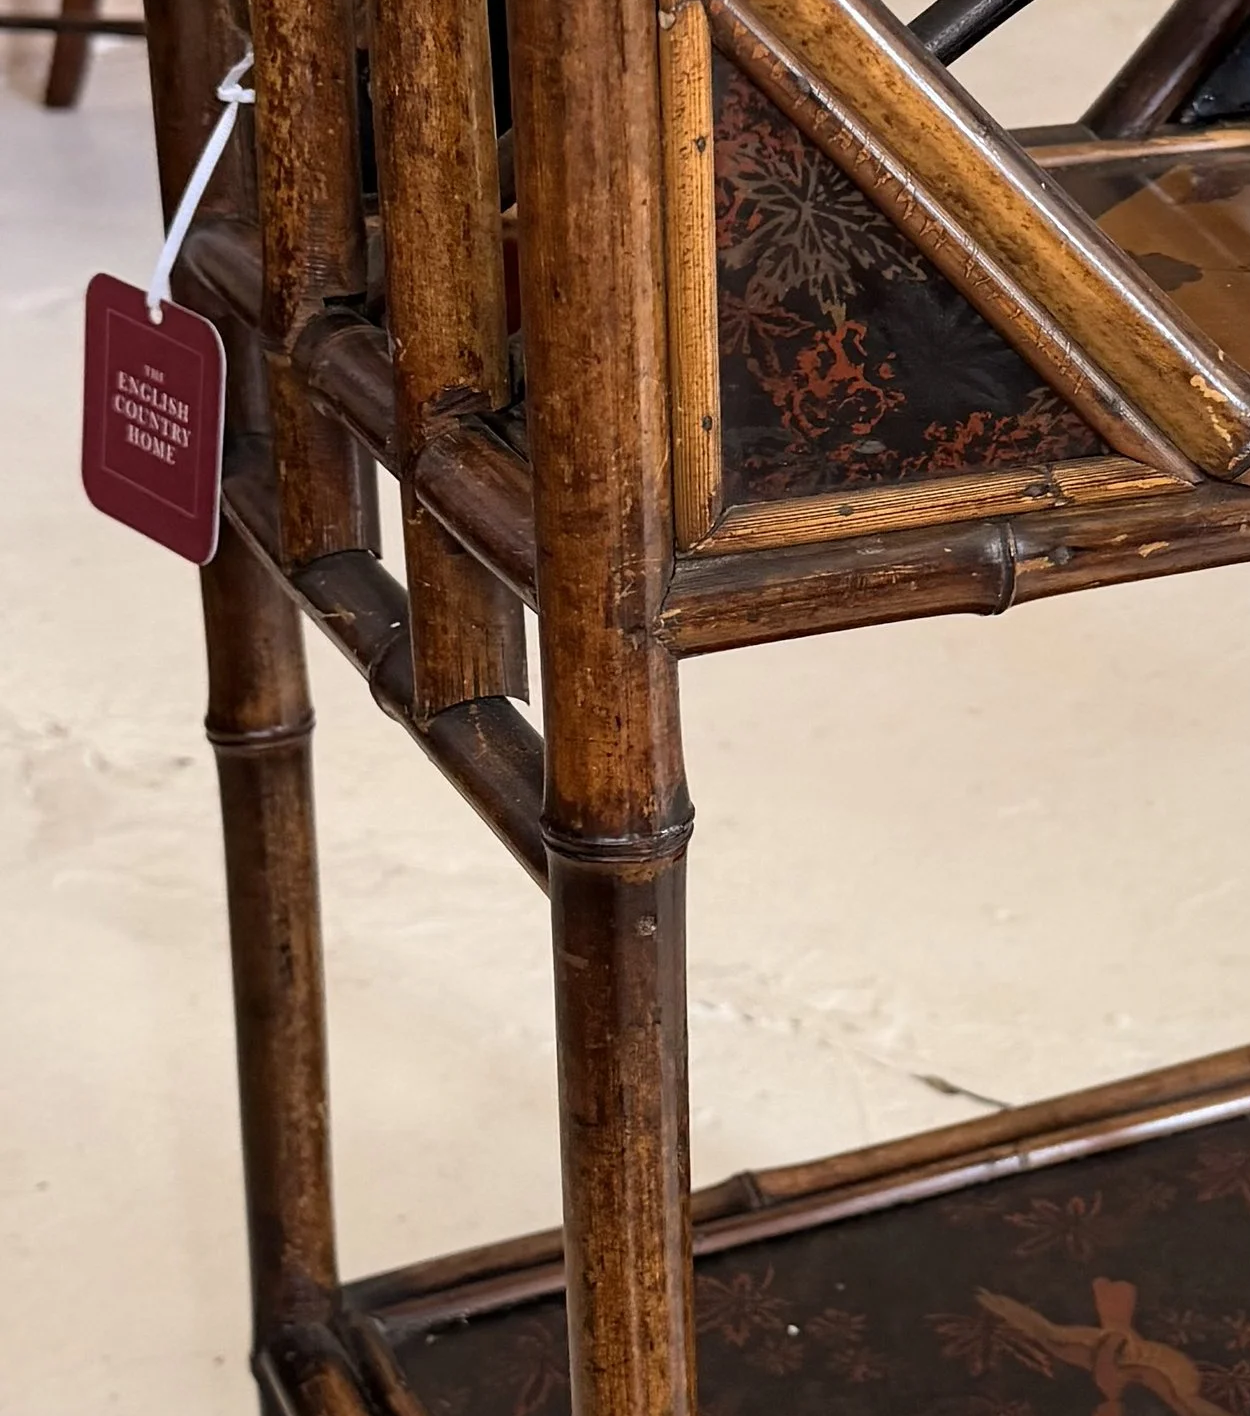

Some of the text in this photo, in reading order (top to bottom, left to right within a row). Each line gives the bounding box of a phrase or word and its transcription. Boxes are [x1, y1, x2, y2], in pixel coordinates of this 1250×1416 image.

[118, 370, 189, 423] ENGLISH
[144, 364, 164, 383] THE
[114, 394, 191, 448] COUNTRY
[127, 423, 176, 465] HOME
